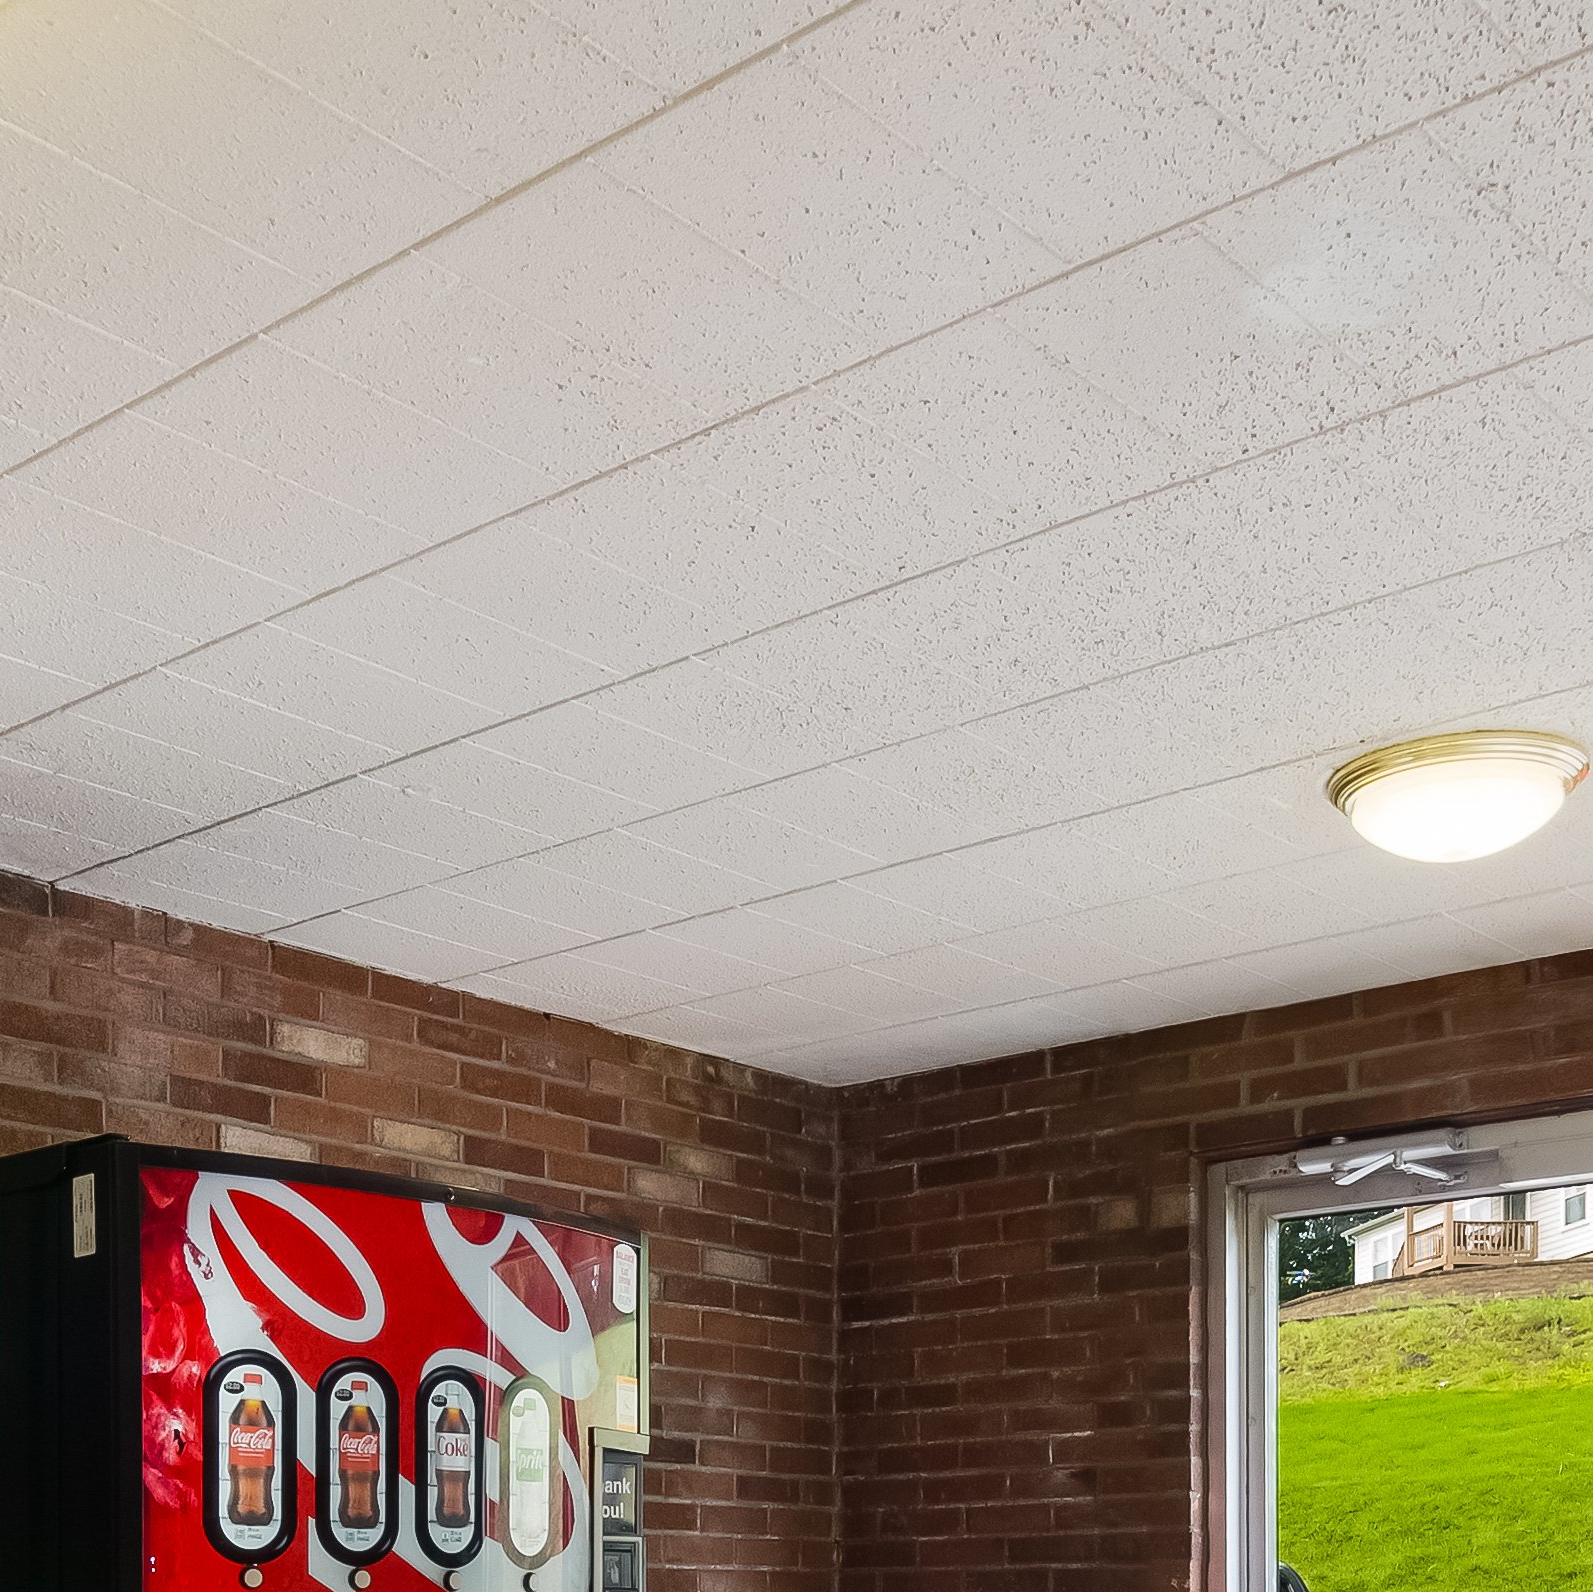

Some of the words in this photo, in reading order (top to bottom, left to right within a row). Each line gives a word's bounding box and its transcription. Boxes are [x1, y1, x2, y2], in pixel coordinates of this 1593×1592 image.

[230, 1427, 274, 1449] Coca-Cola
[340, 1433, 378, 1454] Coca-Cola
[437, 1435, 469, 1457] Coke
[604, 1477, 631, 1494] ank
[602, 1502, 624, 1519] ou!
